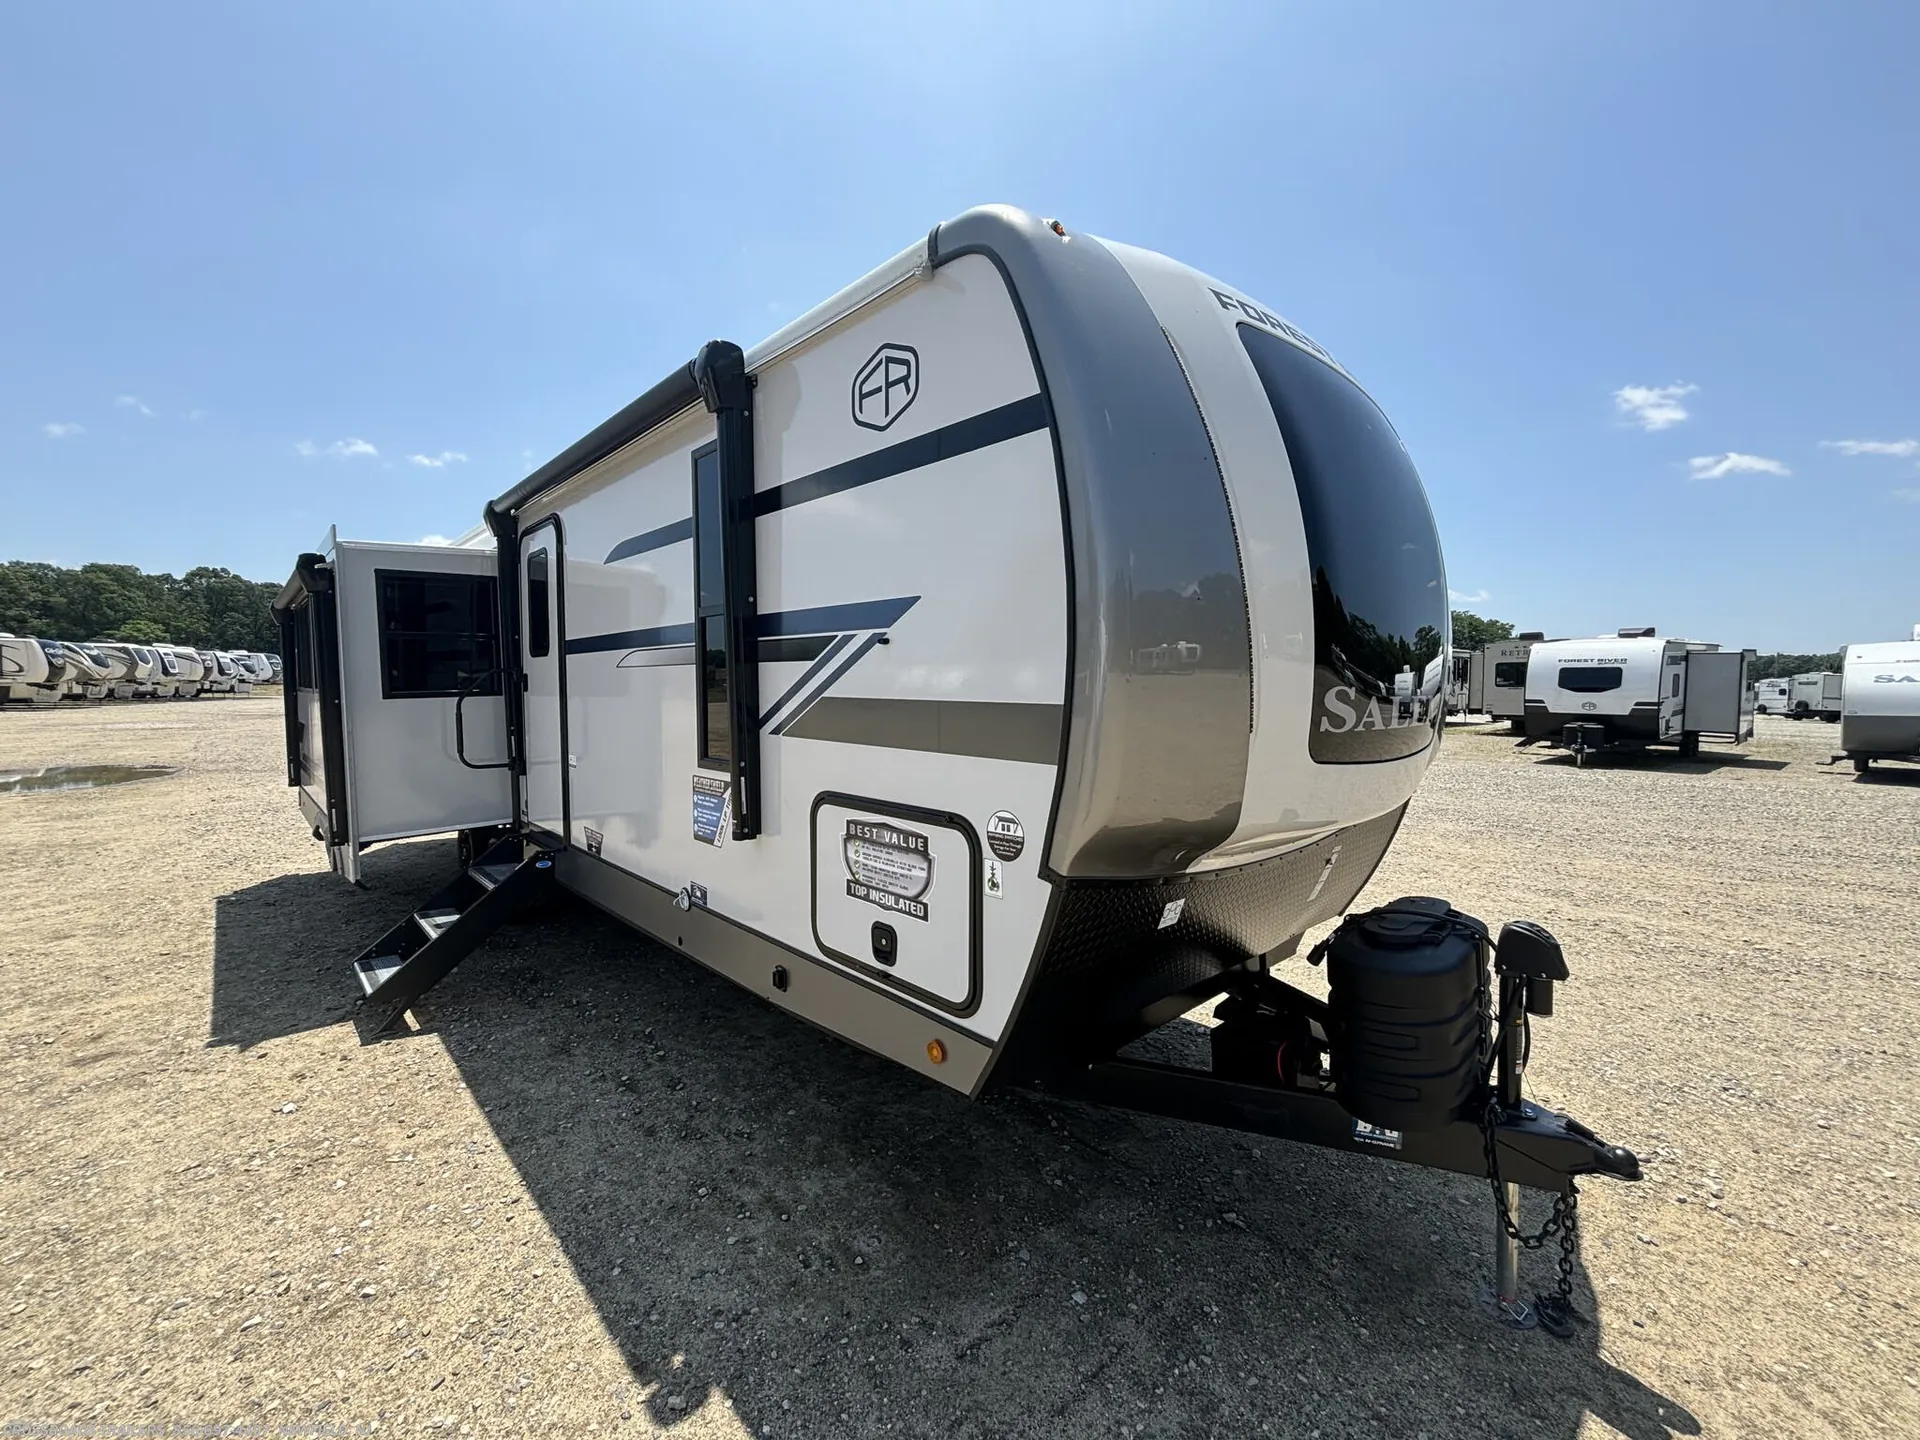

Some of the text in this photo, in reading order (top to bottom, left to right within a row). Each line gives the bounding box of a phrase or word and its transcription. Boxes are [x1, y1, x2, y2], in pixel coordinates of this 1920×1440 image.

[849, 823, 925, 851] BEST VALUE
[850, 883, 925, 917] TOP INSULATED
